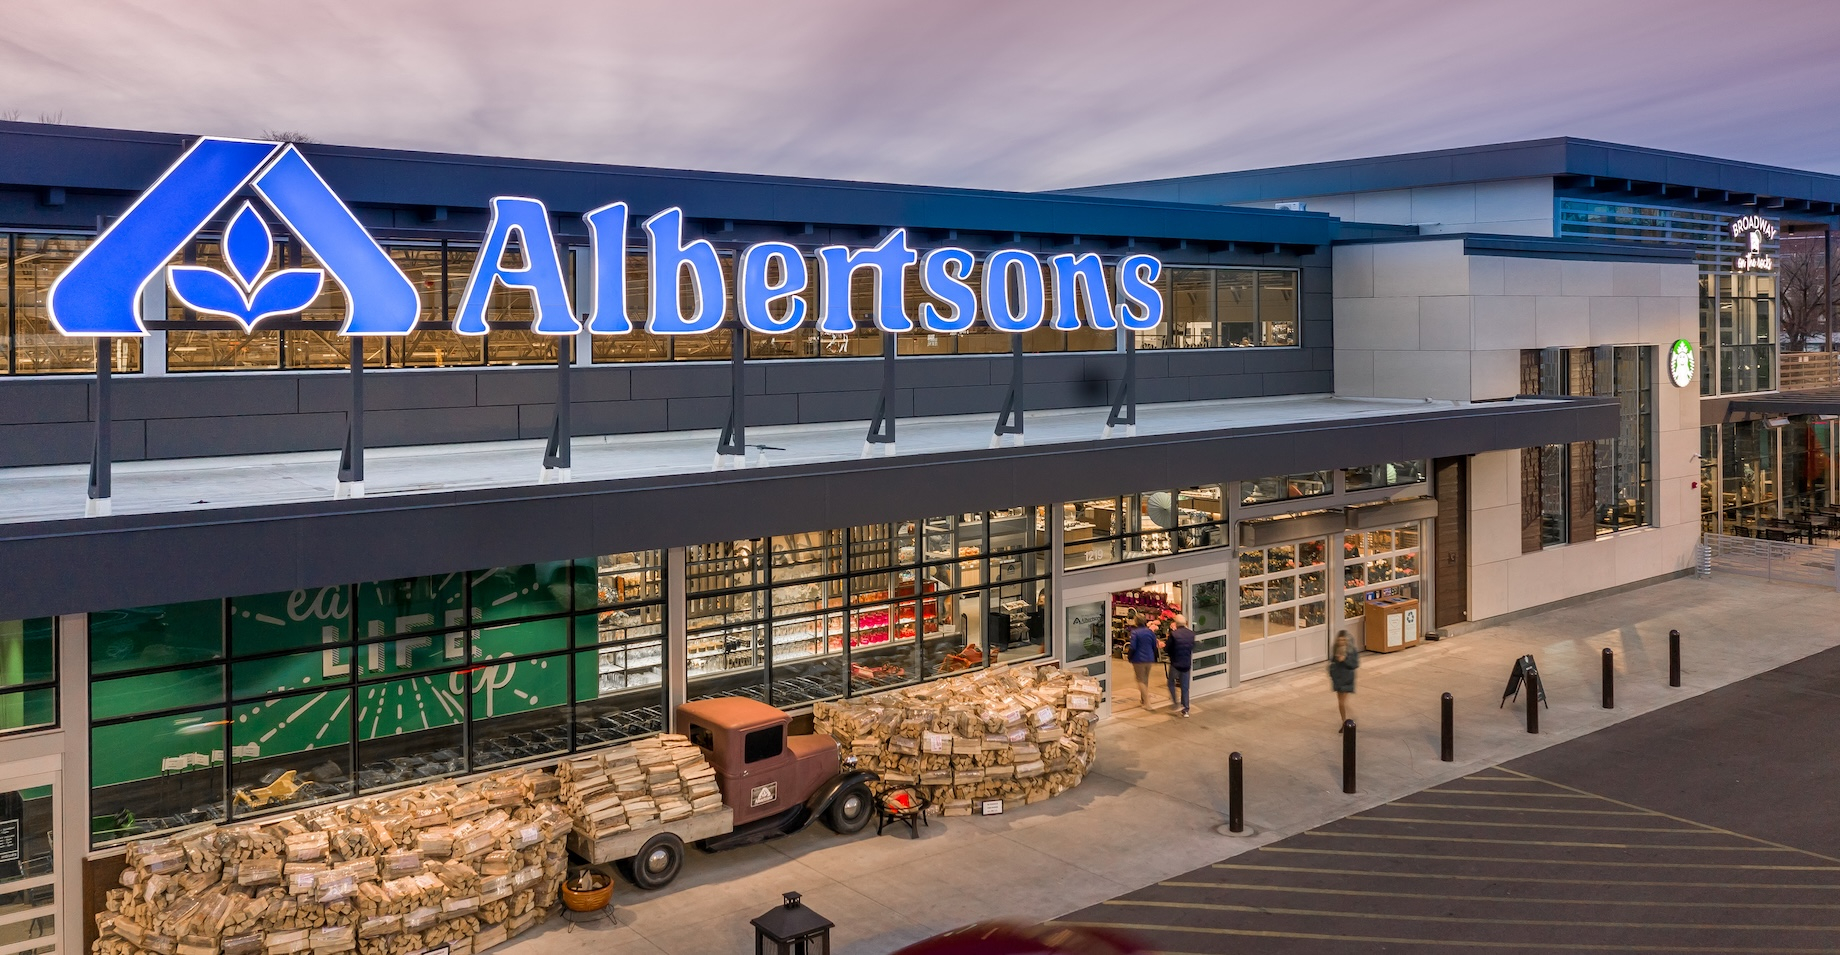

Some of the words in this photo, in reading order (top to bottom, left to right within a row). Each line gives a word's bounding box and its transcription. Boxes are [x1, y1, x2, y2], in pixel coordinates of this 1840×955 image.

[1732, 215, 1776, 240] BROADWAY
[454, 196, 1164, 336] Albertsons
[1084, 549, 1103, 561] 1219
[287, 585, 355, 621] ea
[322, 607, 482, 680] LIFE
